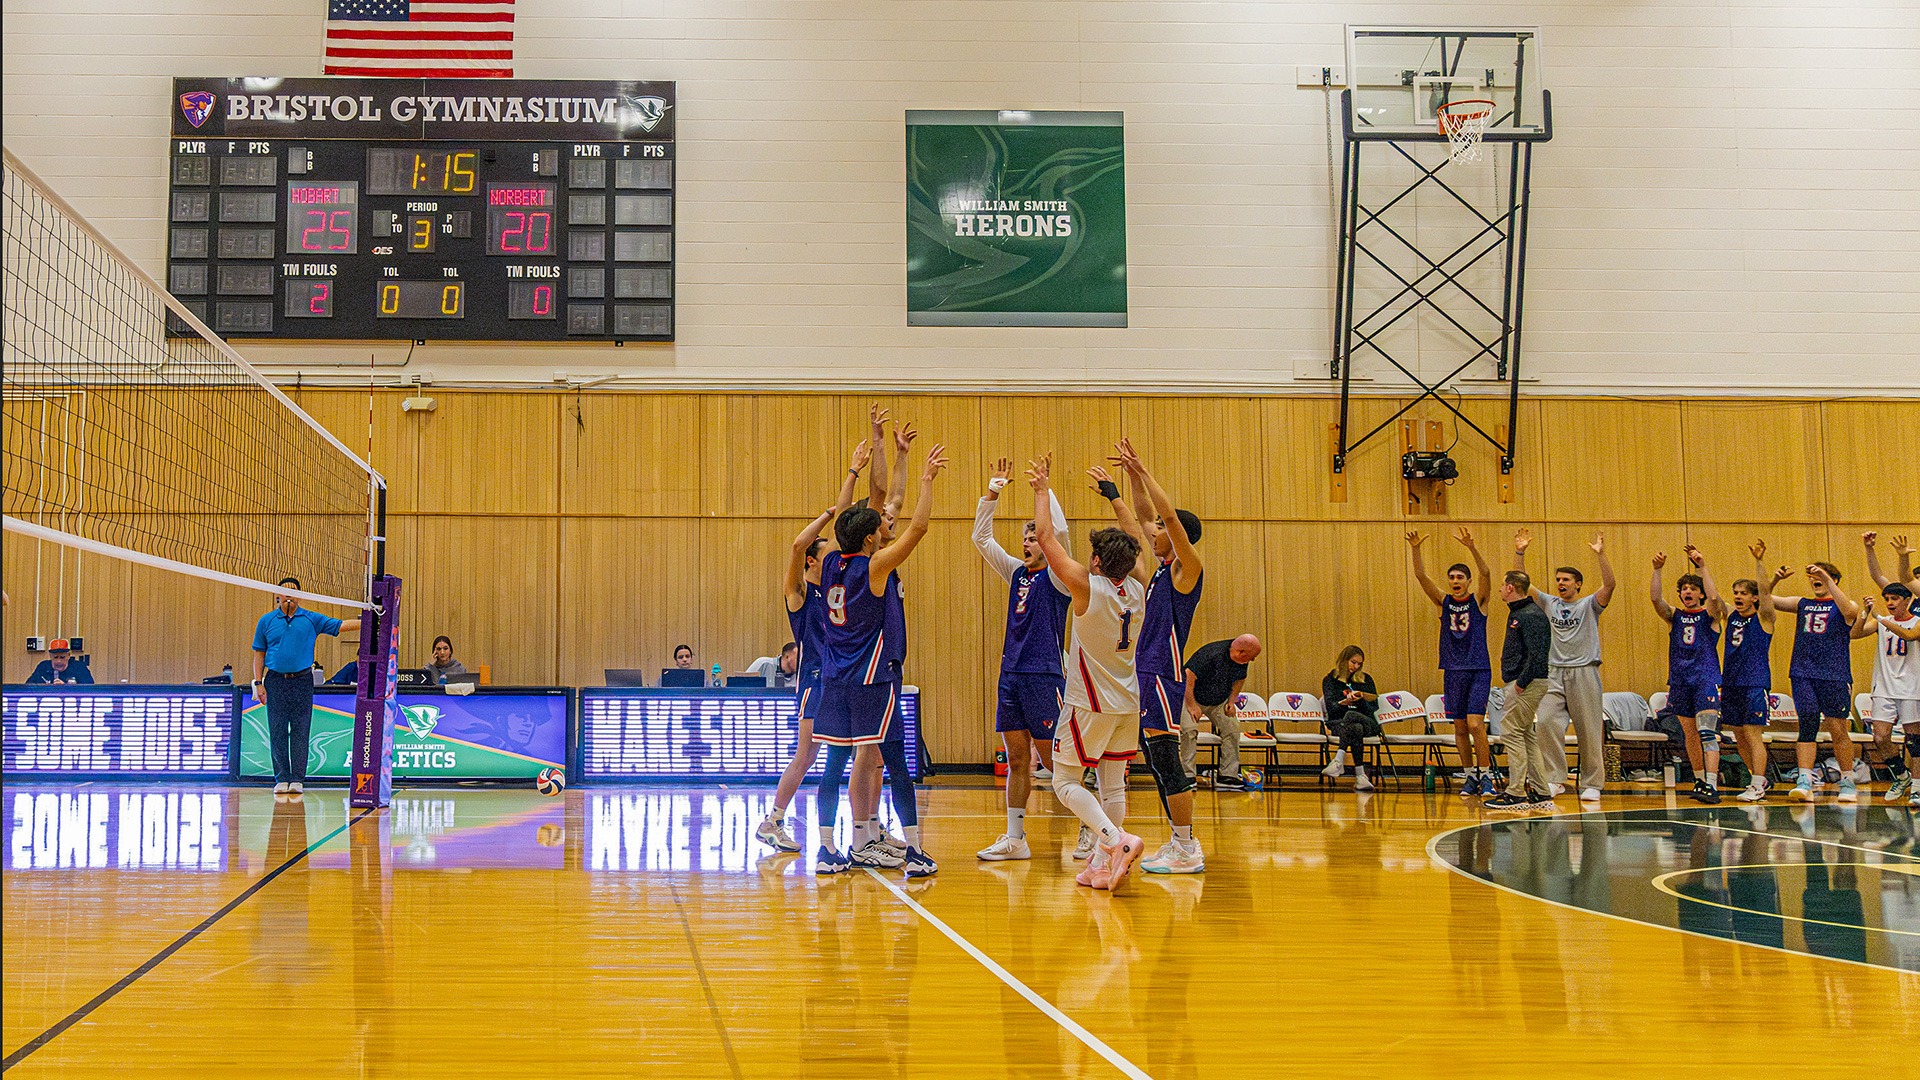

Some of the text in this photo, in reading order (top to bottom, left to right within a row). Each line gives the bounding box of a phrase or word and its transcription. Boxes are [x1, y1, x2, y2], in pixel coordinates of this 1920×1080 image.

[226, 95, 617, 123] BRISTOL GYMNASIUM
[179, 141, 206, 154] PLYR
[228, 141, 235, 154] F
[249, 141, 270, 154] PTS
[573, 145, 600, 157] PLYR
[623, 145, 630, 157] F
[643, 145, 665, 157] PTS
[307, 151, 313, 160] B
[533, 152, 539, 162] B
[307, 161, 313, 171] B
[412, 153, 475, 192] 1:15
[533, 163, 539, 172] B
[291, 187, 340, 204] HOBART
[490, 189, 546, 206] NORBERT
[406, 202, 438, 212] PERIOD
[957, 200, 1068, 212] WILLIAM SMITH
[391, 214, 398, 223] P
[446, 214, 453, 223] P
[954, 214, 1072, 237] HERONS
[302, 209, 352, 250] 25
[391, 224, 403, 233] TO
[413, 219, 431, 249] 3
[442, 225, 453, 234] TO
[501, 211, 551, 252] 20
[283, 263, 338, 276] TM FOULS
[383, 267, 399, 277] TOL
[443, 267, 459, 277] TOL
[506, 265, 560, 278] TM FOULS
[310, 284, 328, 313] 2
[381, 285, 400, 315] 0
[441, 285, 460, 315] 0
[533, 285, 551, 315] 0
[827, 584, 847, 626] 9
[1449, 612, 1470, 631] 13
[1803, 612, 1829, 634] 15
[1116, 608, 1133, 652] 1
[1682, 624, 1696, 645] 8
[1732, 627, 1744, 647] 5
[1885, 636, 1907, 657] 10
[1236, 711, 1267, 719] ESMEN
[1270, 710, 1321, 718] STATESMEN
[1378, 707, 1425, 721] STATESMEN
[15, 696, 113, 770] SOME
[120, 697, 226, 770] NOISE
[592, 700, 799, 772] MAKE SOME
[363, 737, 371, 768] imports
